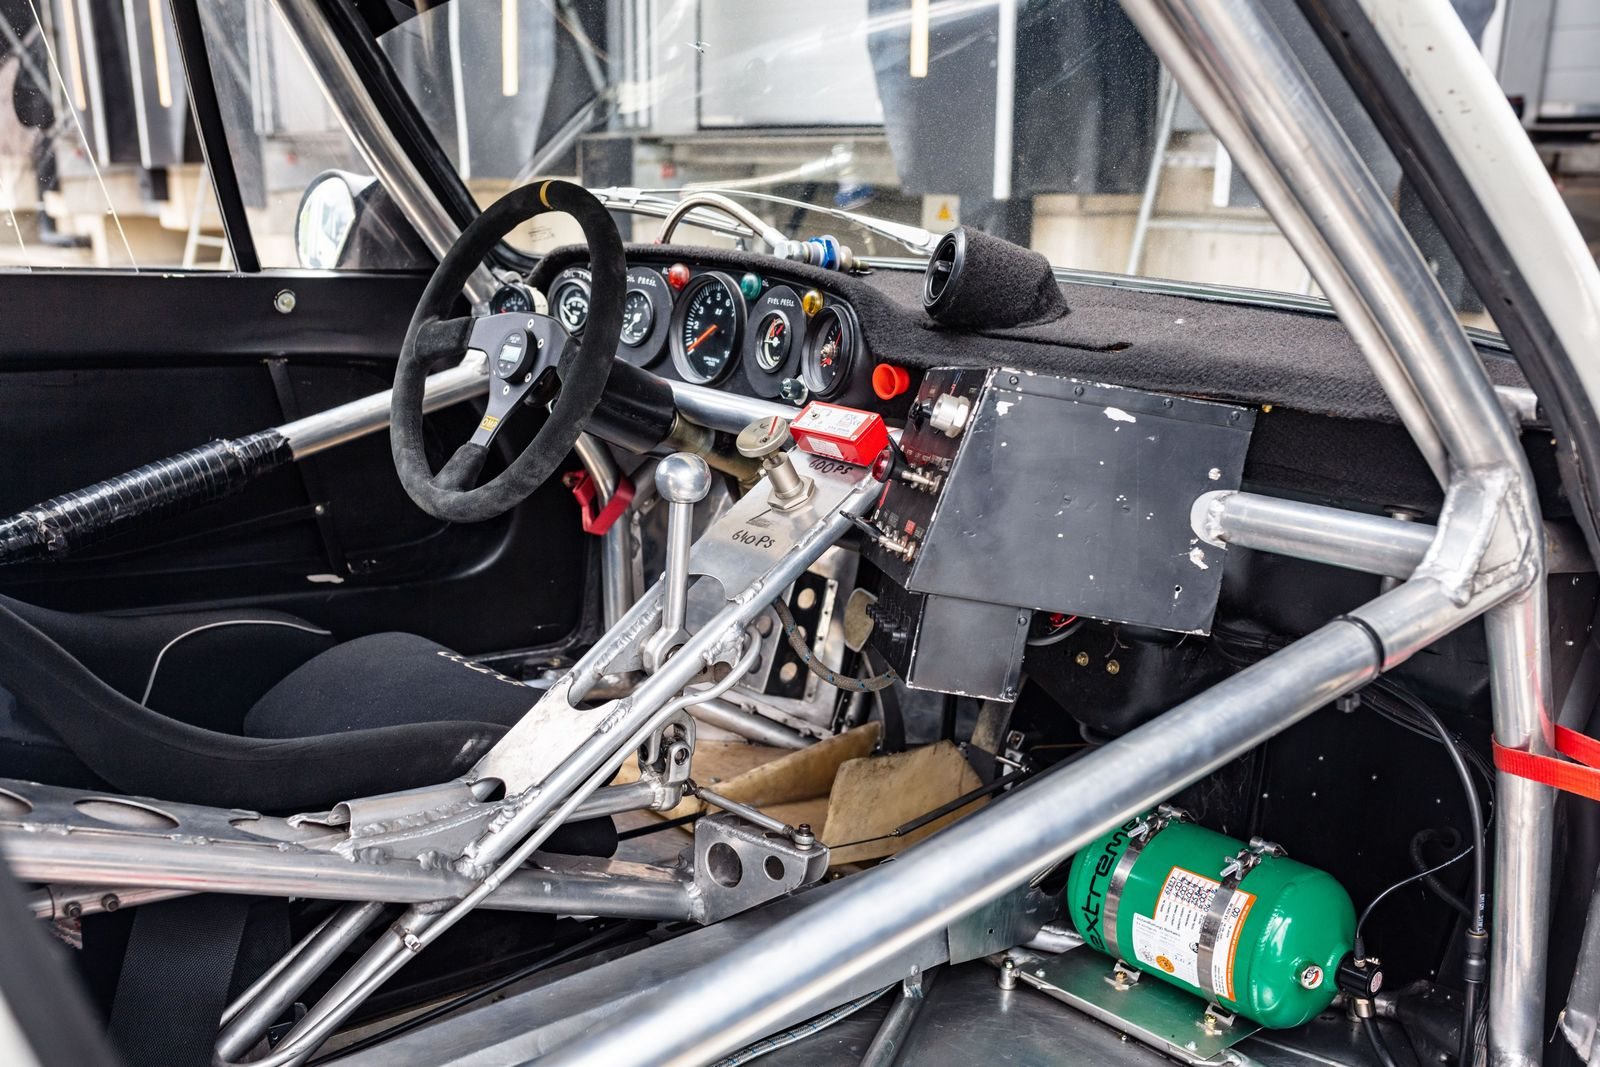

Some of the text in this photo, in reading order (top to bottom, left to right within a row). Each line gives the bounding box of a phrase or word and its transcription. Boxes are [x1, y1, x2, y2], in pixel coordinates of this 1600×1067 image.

[706, 297, 712, 305] 4
[716, 293, 722, 301] 5
[767, 297, 780, 305] FUEL
[725, 299, 731, 307] 6
[698, 306, 704, 315] 3
[693, 321, 699, 330] 2
